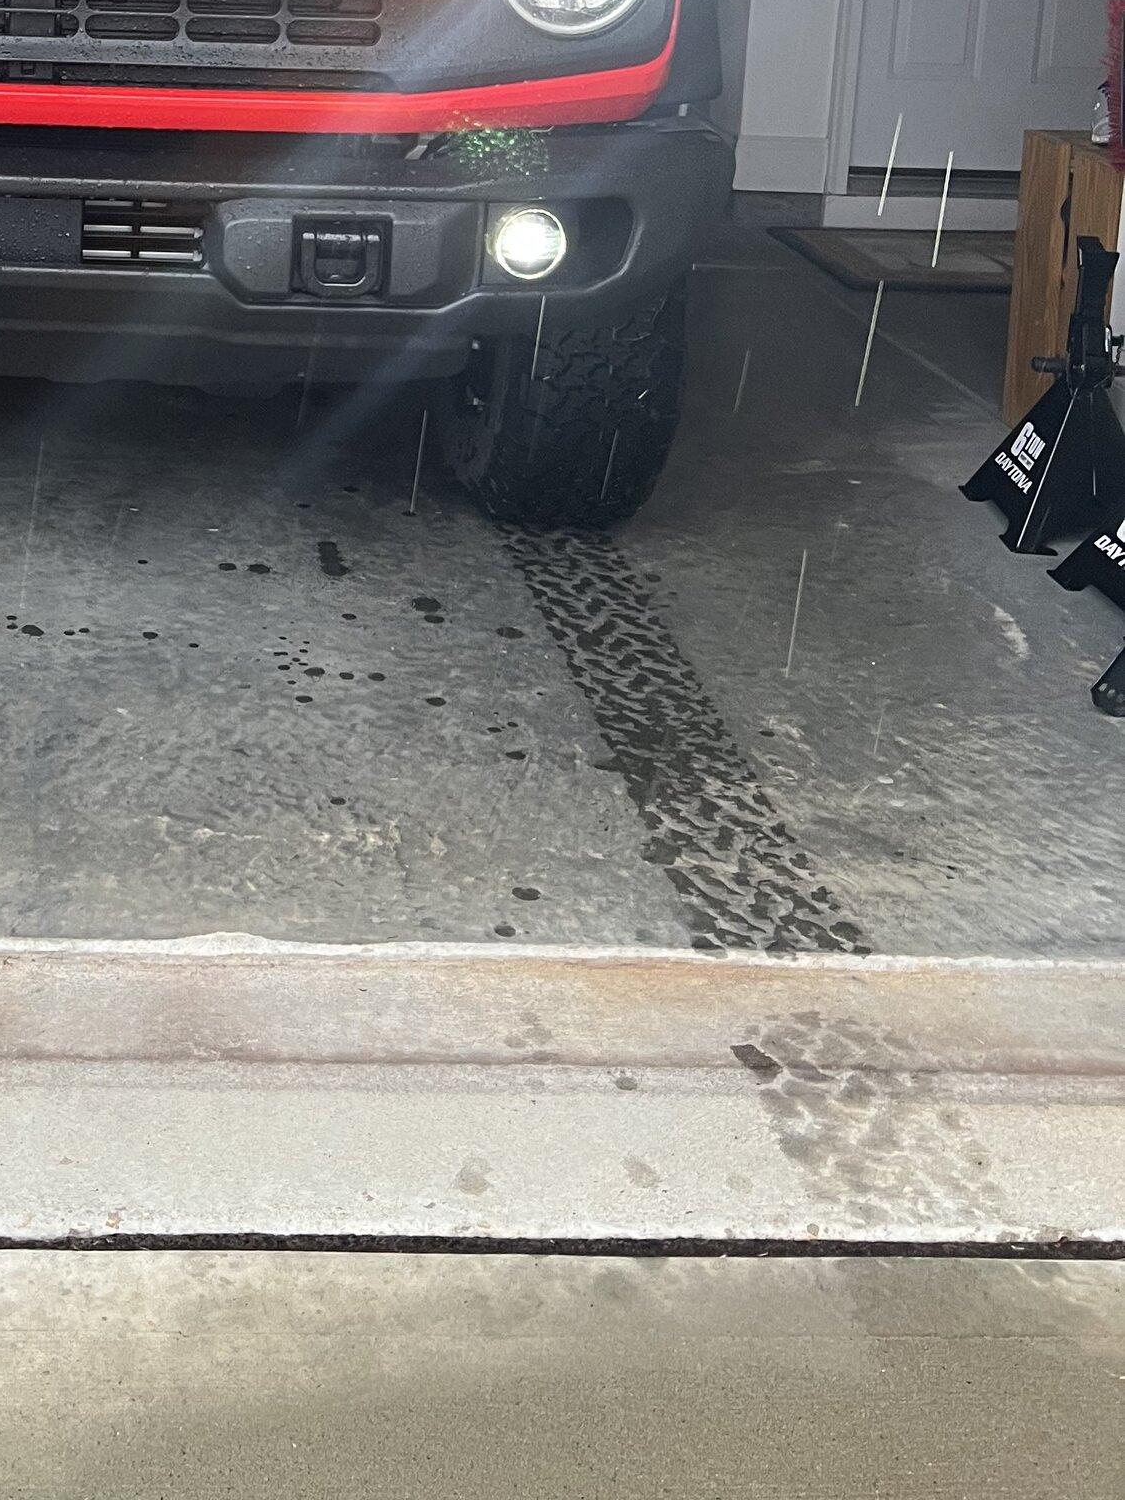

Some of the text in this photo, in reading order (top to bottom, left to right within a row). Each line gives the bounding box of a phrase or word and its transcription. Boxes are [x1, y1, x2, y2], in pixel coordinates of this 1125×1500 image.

[1010, 421, 1046, 460] 6 TON
[994, 451, 1034, 494] DAYTONA
